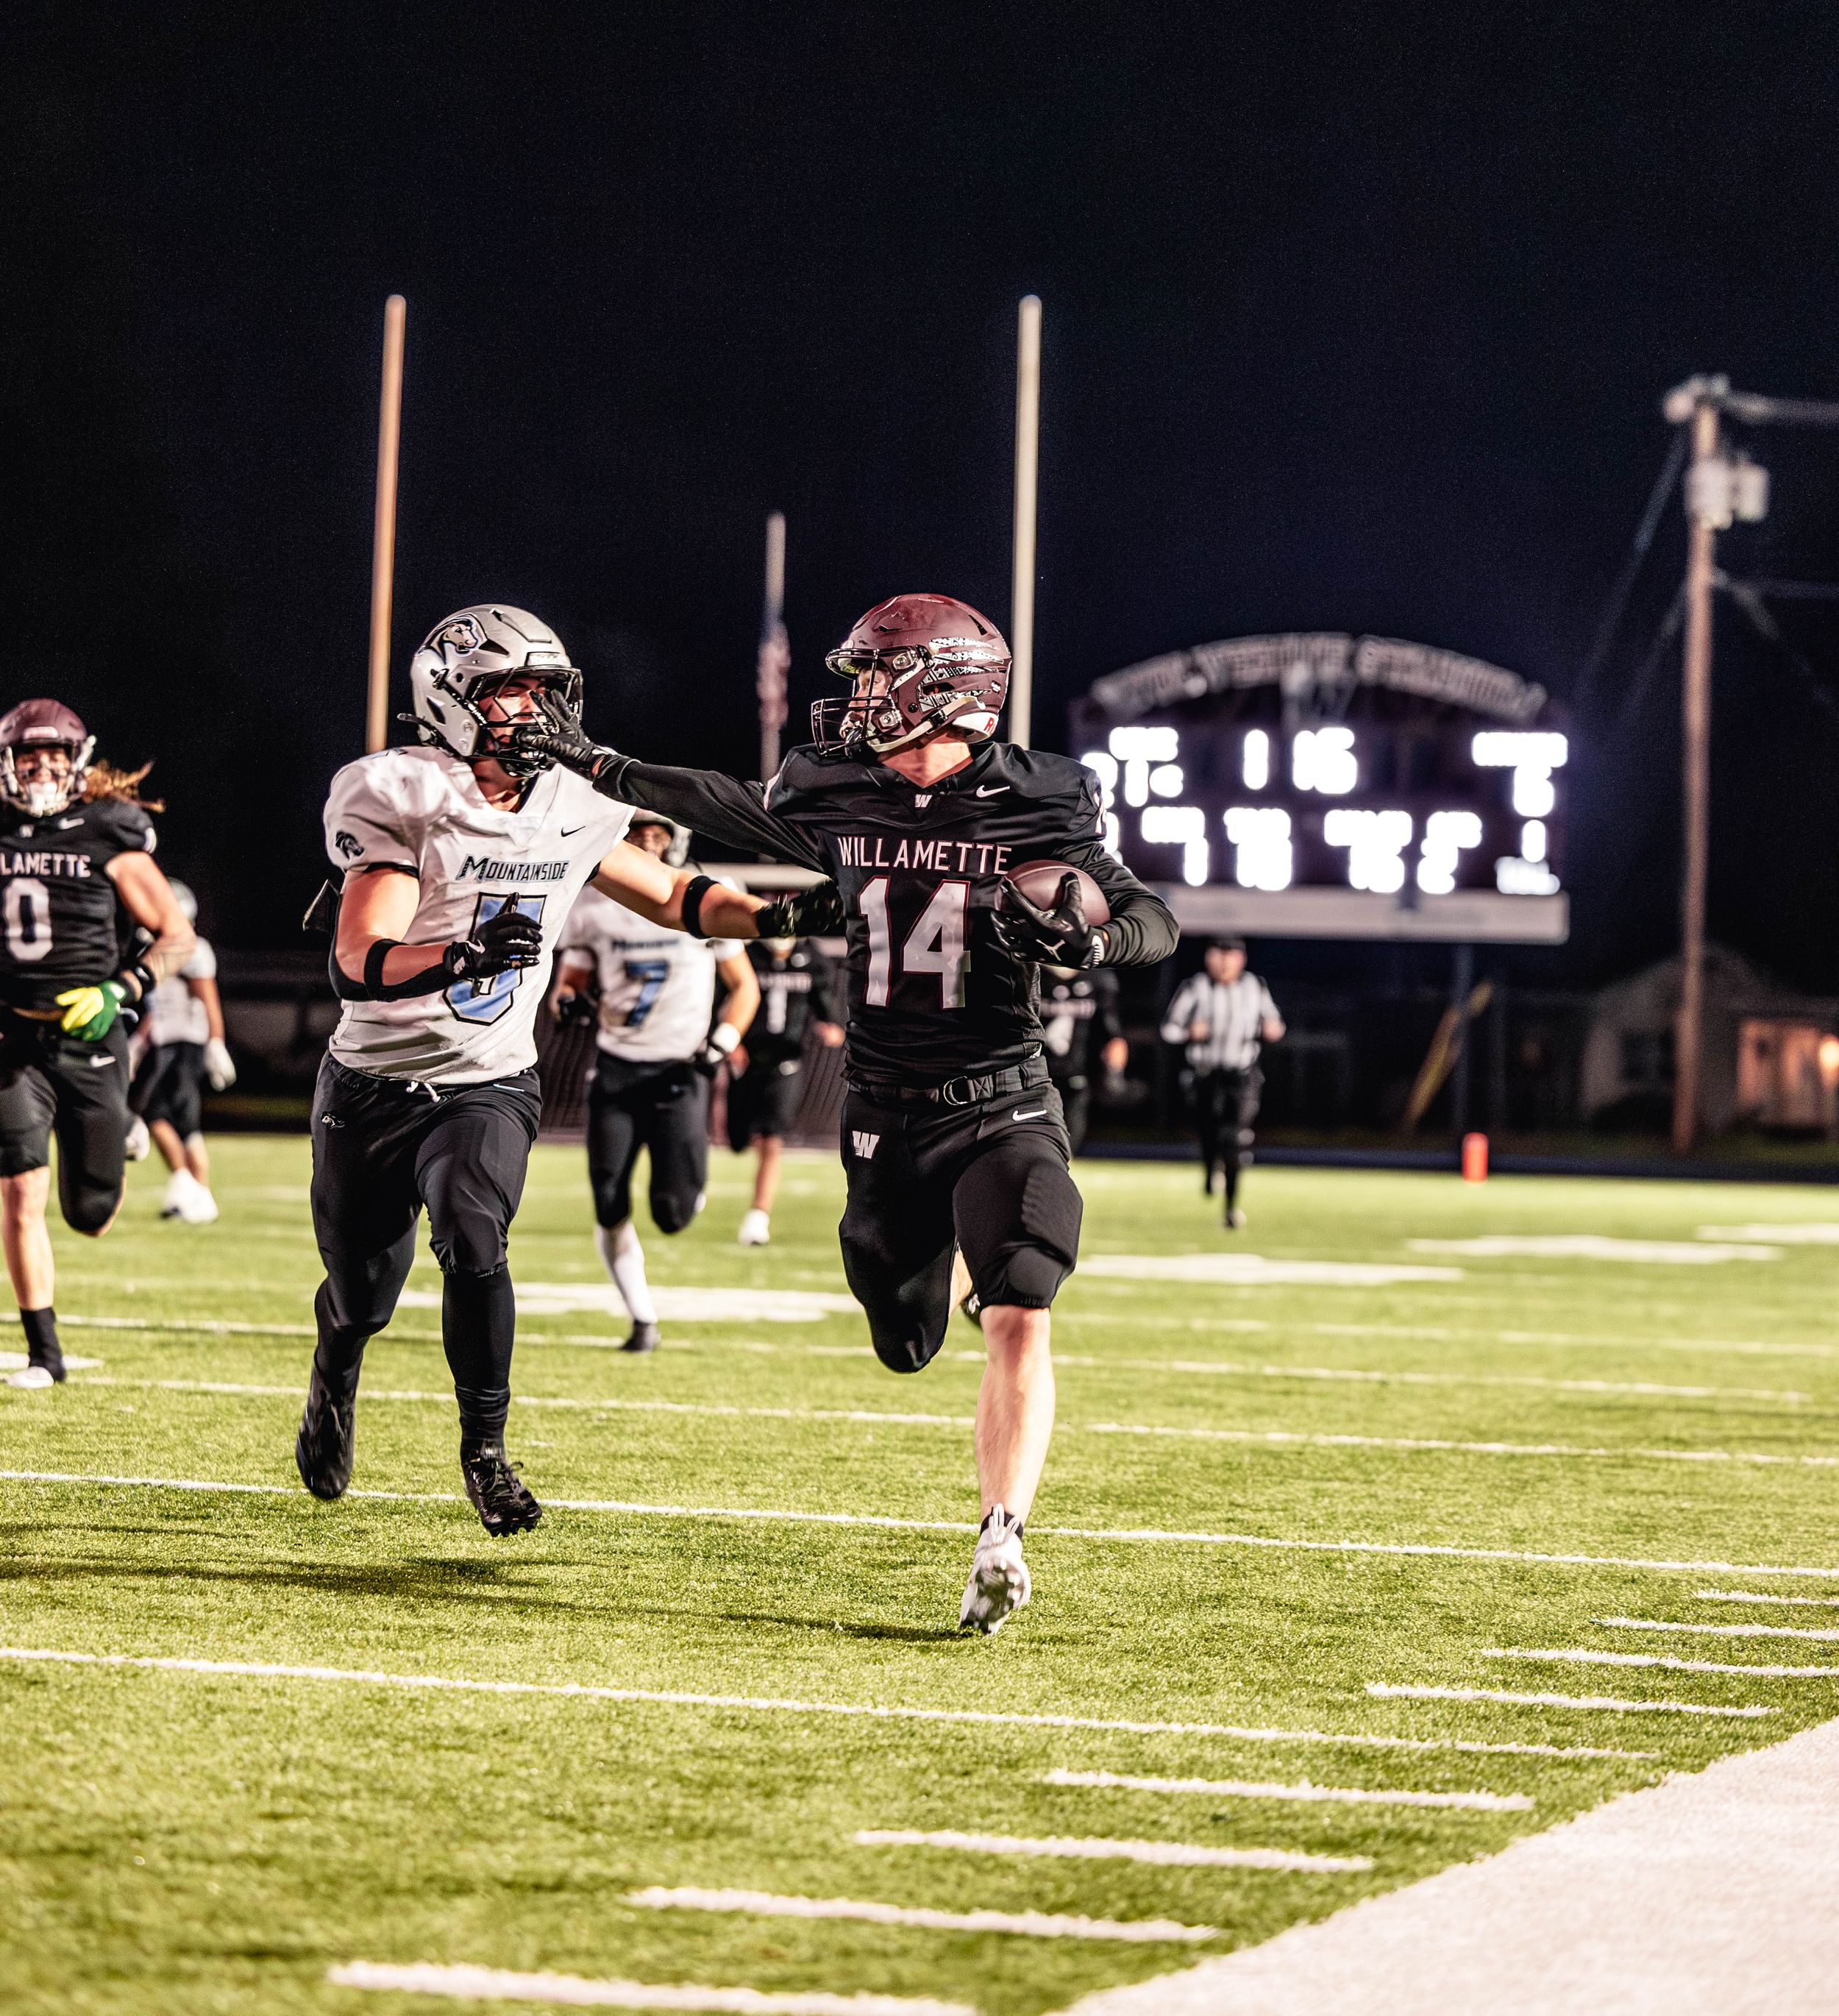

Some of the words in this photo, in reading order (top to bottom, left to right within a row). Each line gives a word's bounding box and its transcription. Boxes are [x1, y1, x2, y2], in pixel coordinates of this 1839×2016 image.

[914, 794, 933, 808] W
[455, 853, 570, 884] MOUNTAINSIDE
[836, 836, 1012, 875] WILLAMETTE
[4, 878, 54, 961] 0
[858, 875, 972, 1010] 14
[625, 959, 671, 1027] 7
[852, 1130, 881, 1160] W
